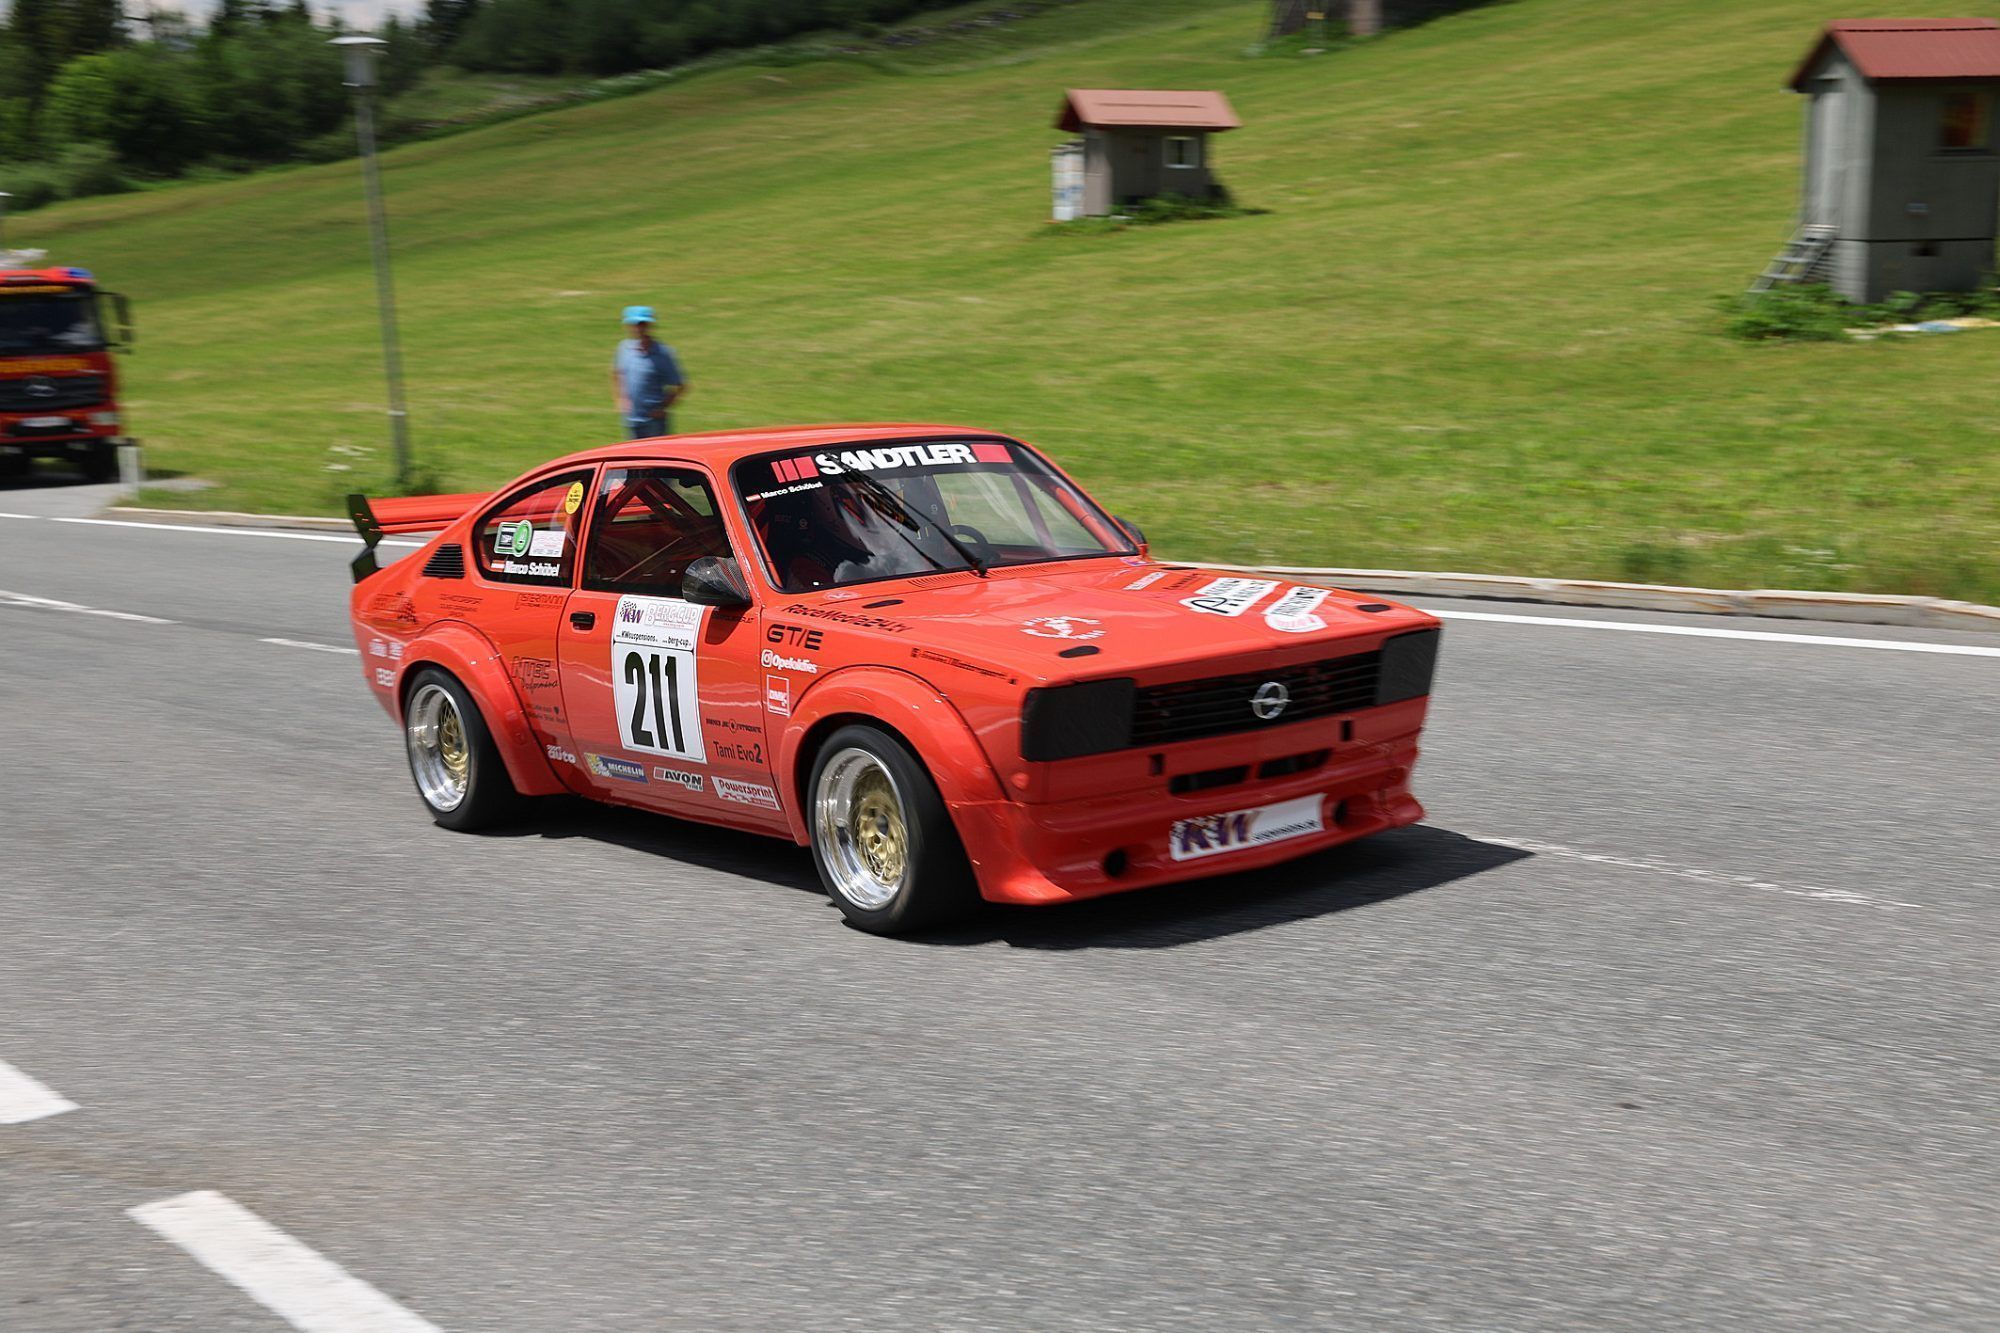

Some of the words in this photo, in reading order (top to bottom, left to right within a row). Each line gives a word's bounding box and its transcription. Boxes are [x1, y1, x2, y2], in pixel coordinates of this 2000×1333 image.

[815, 444, 977, 475] SANDTLER
[766, 624, 824, 651] GT/E
[625, 651, 686, 753] 211
[548, 750, 577, 765] auto
[713, 741, 736, 759] Tami
[607, 762, 645, 777] MICHELIN
[664, 770, 702, 787] AVON
[718, 779, 775, 799] Powersprint
